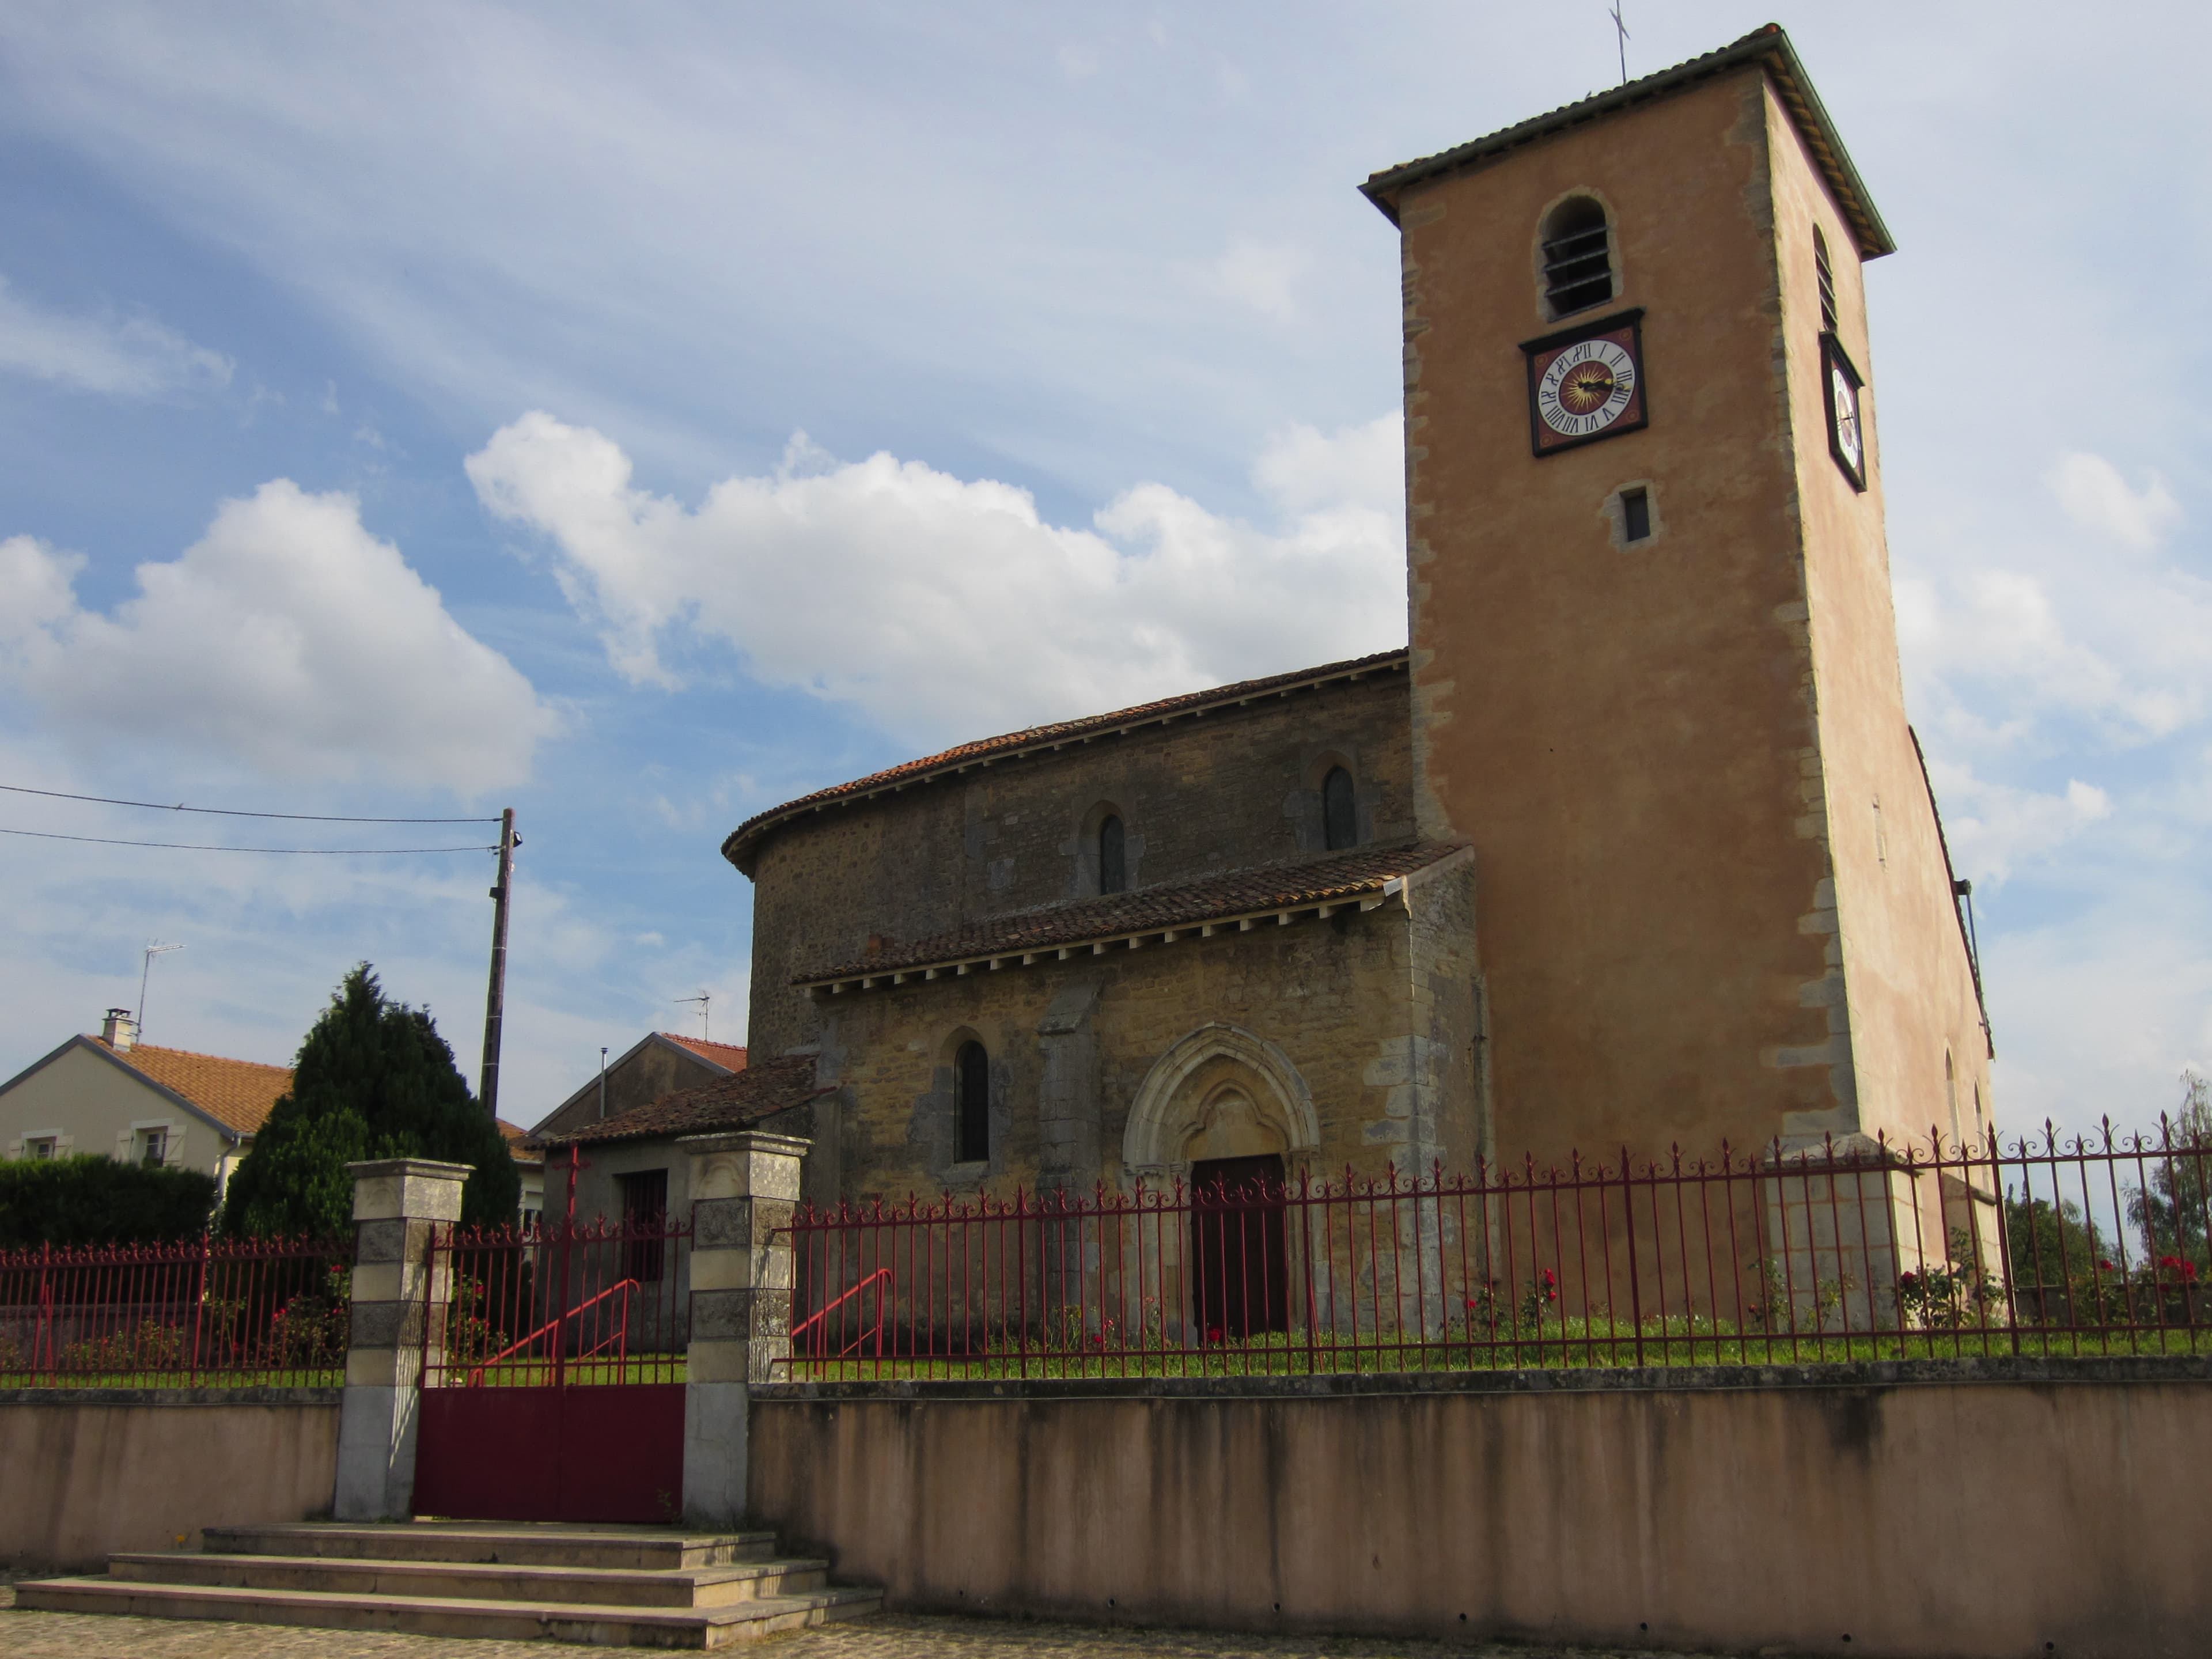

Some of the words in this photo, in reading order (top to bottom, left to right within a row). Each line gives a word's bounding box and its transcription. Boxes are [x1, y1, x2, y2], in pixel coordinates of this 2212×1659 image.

[1599, 343, 1607, 358] I
[1610, 352, 1626, 367] II
[1546, 373, 1559, 386] X
[1616, 369, 1633, 383] III
[1546, 406, 1566, 428] VIII
[1602, 407, 1615, 421] V
[1562, 416, 1578, 433] VII
[1585, 415, 1599, 431] VI
